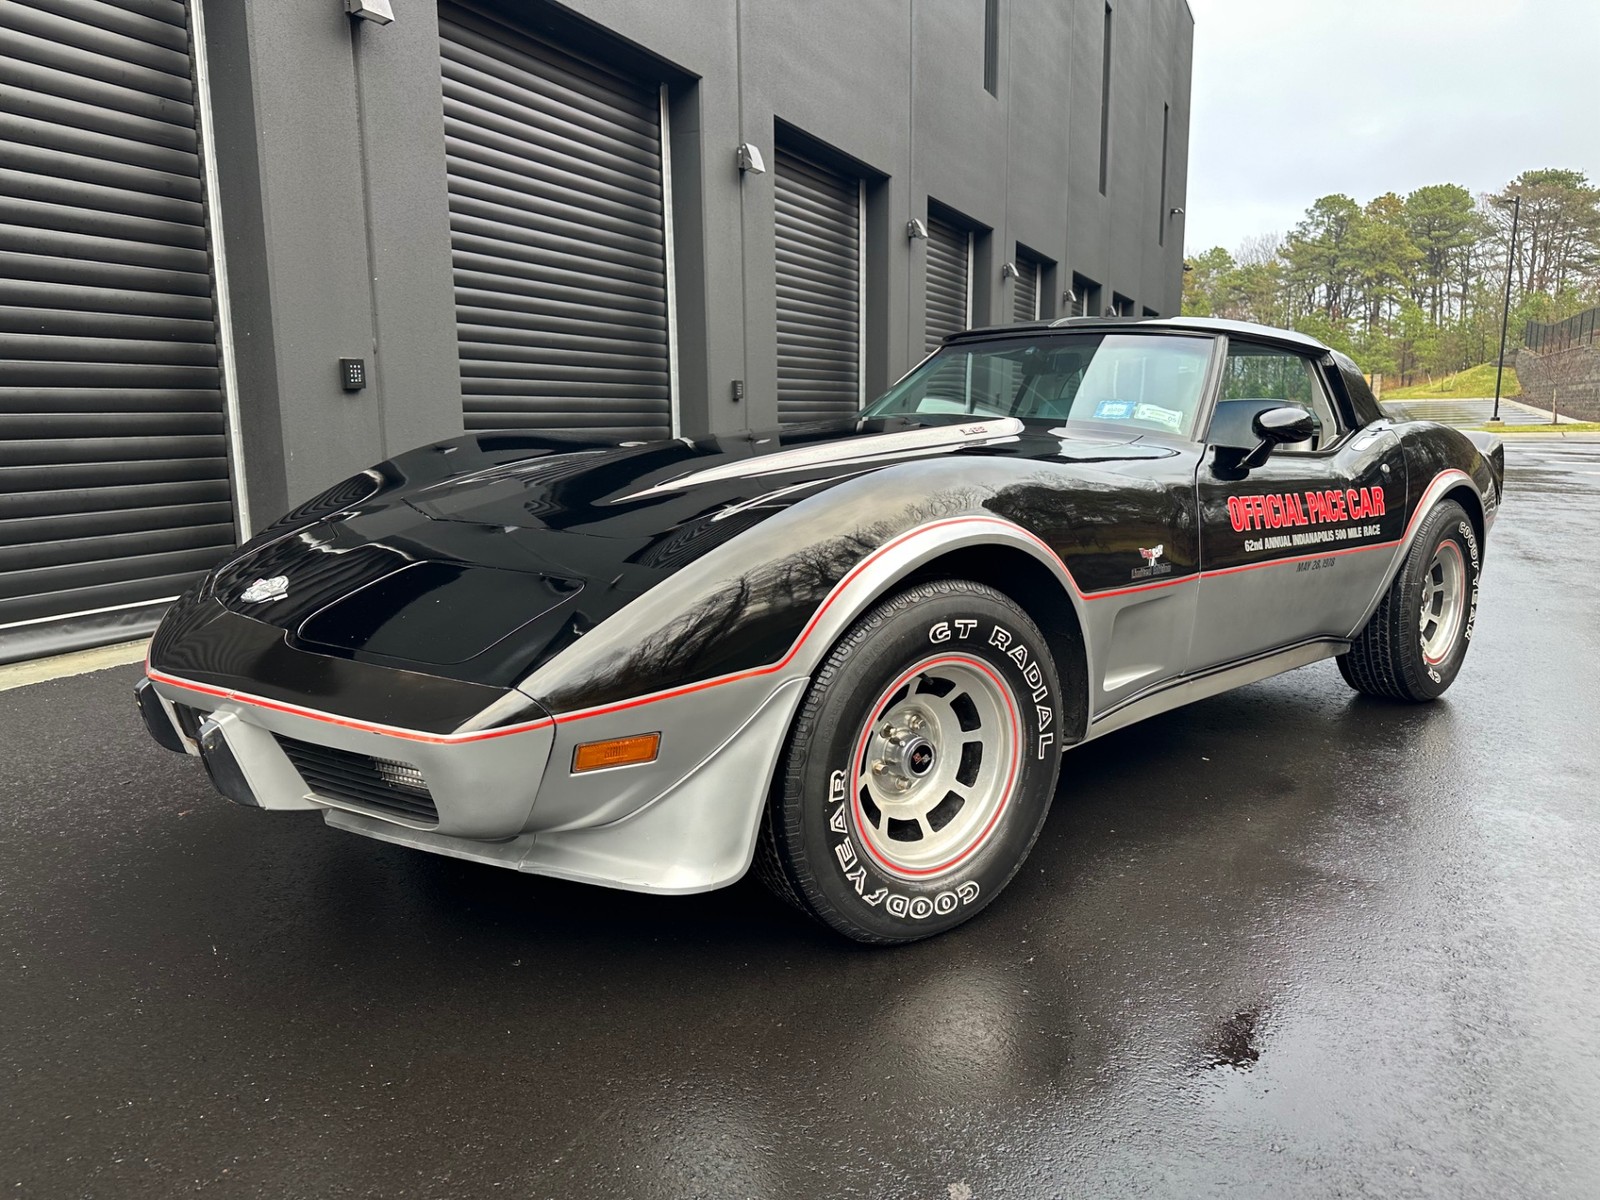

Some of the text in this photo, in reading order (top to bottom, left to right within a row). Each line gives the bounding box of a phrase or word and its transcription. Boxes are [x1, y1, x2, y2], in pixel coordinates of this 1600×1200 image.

[1227, 486, 1386, 532] OFFICIAL PACE CAR
[1244, 524, 1381, 552] 62nd ANNUAL INDIANAPOLIS 500 MILE RACE
[1296, 557, 1336, 572] MAY 28, 1978
[928, 619, 978, 643] GT
[988, 625, 1055, 760] RADIAL
[828, 769, 981, 919] GOODYEAR
